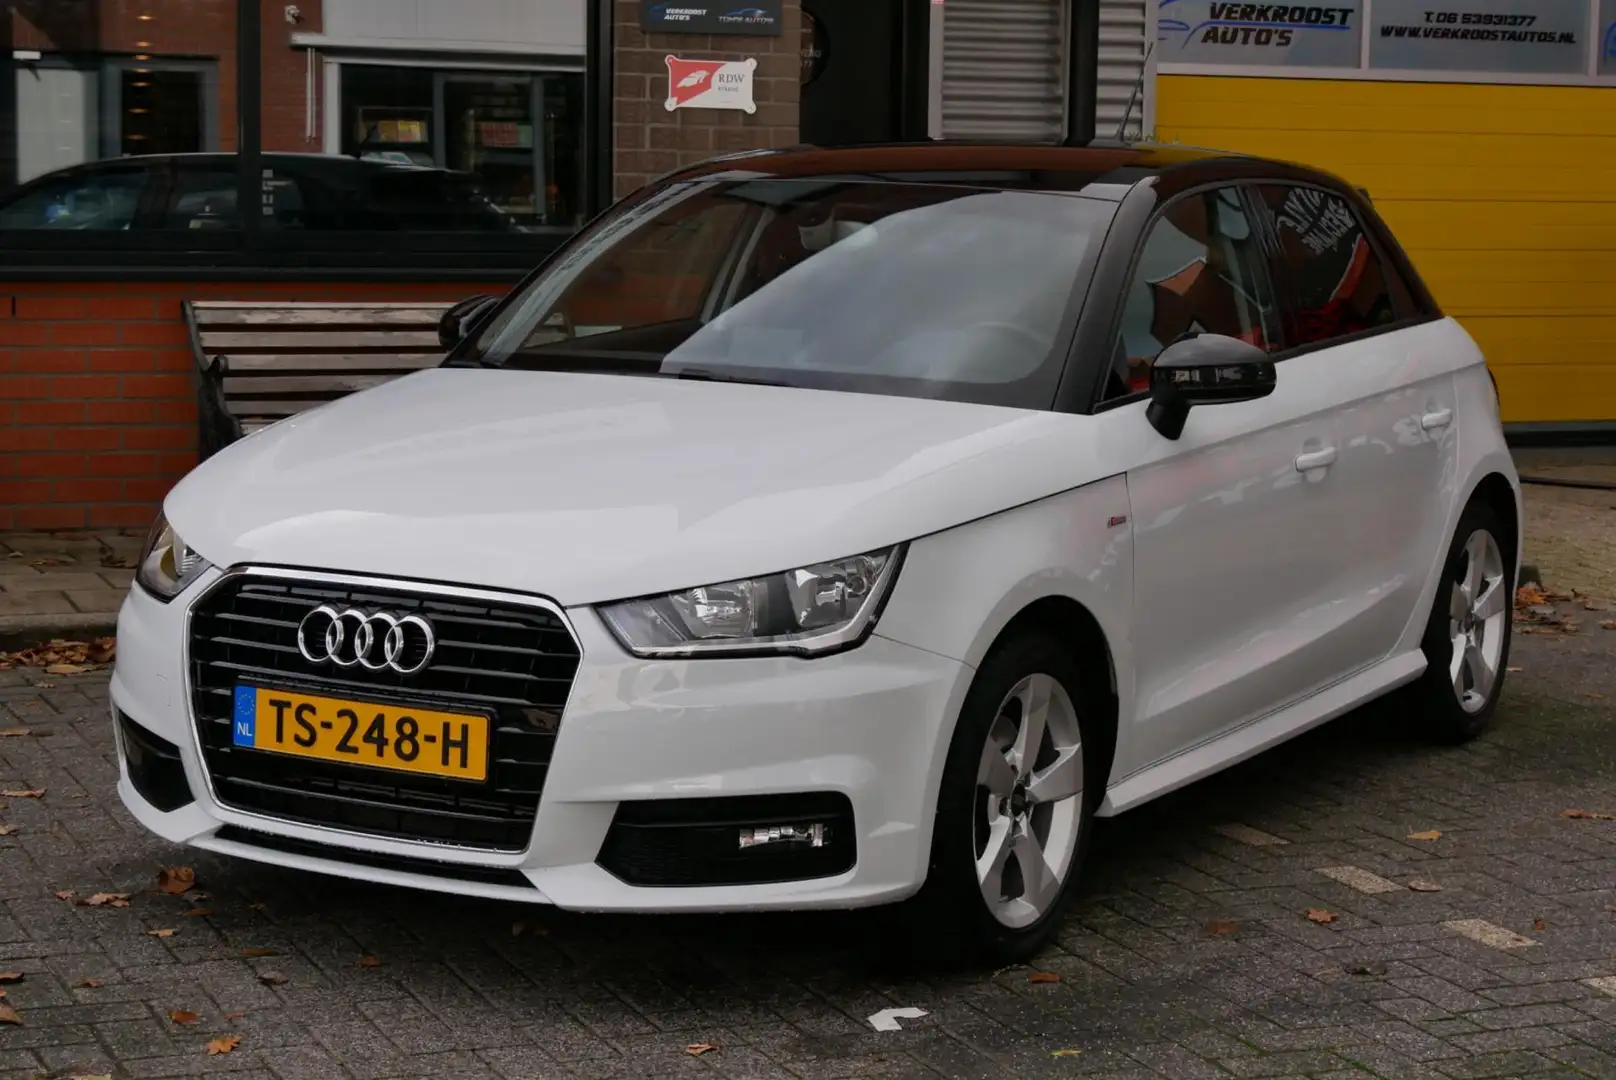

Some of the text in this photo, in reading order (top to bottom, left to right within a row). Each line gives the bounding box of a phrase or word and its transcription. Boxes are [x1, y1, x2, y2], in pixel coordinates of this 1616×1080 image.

[1209, 1, 1354, 25] VERKROOST
[1461, 13, 1536, 27] 53931377
[1201, 26, 1293, 47] AUTO'S
[1380, 26, 1577, 44] WWW.VERKROOSTAUTOS.NL
[718, 73, 746, 84] RDW
[237, 721, 253, 737] NL
[268, 698, 469, 769] TS-248-H
